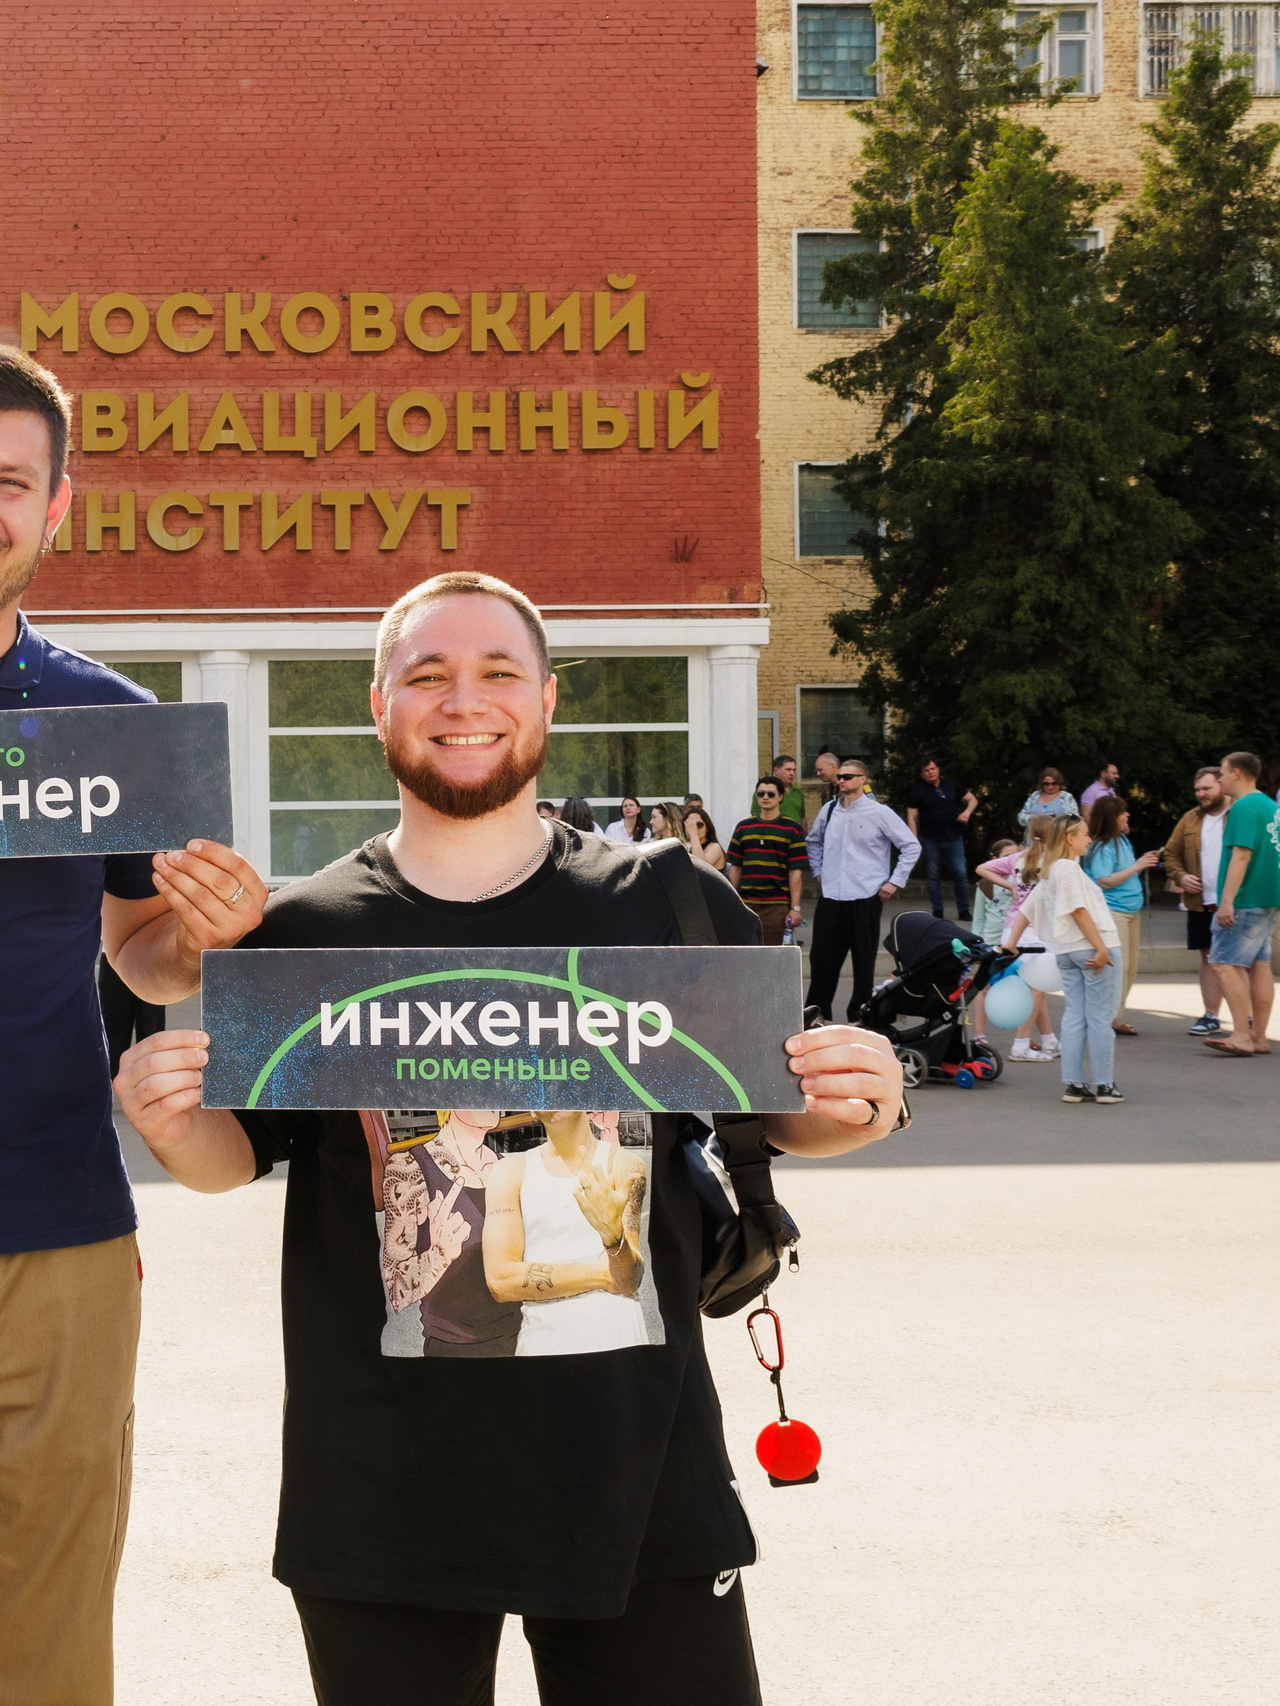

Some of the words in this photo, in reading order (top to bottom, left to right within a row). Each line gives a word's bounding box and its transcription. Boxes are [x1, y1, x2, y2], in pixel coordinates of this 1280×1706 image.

[20, 273, 646, 354] МОСКОВСКИЙ
[66, 371, 719, 458] ВИАЦИОННЫЙ
[320, 1000, 673, 1064] инженер
[396, 1057, 591, 1081] поменьше
